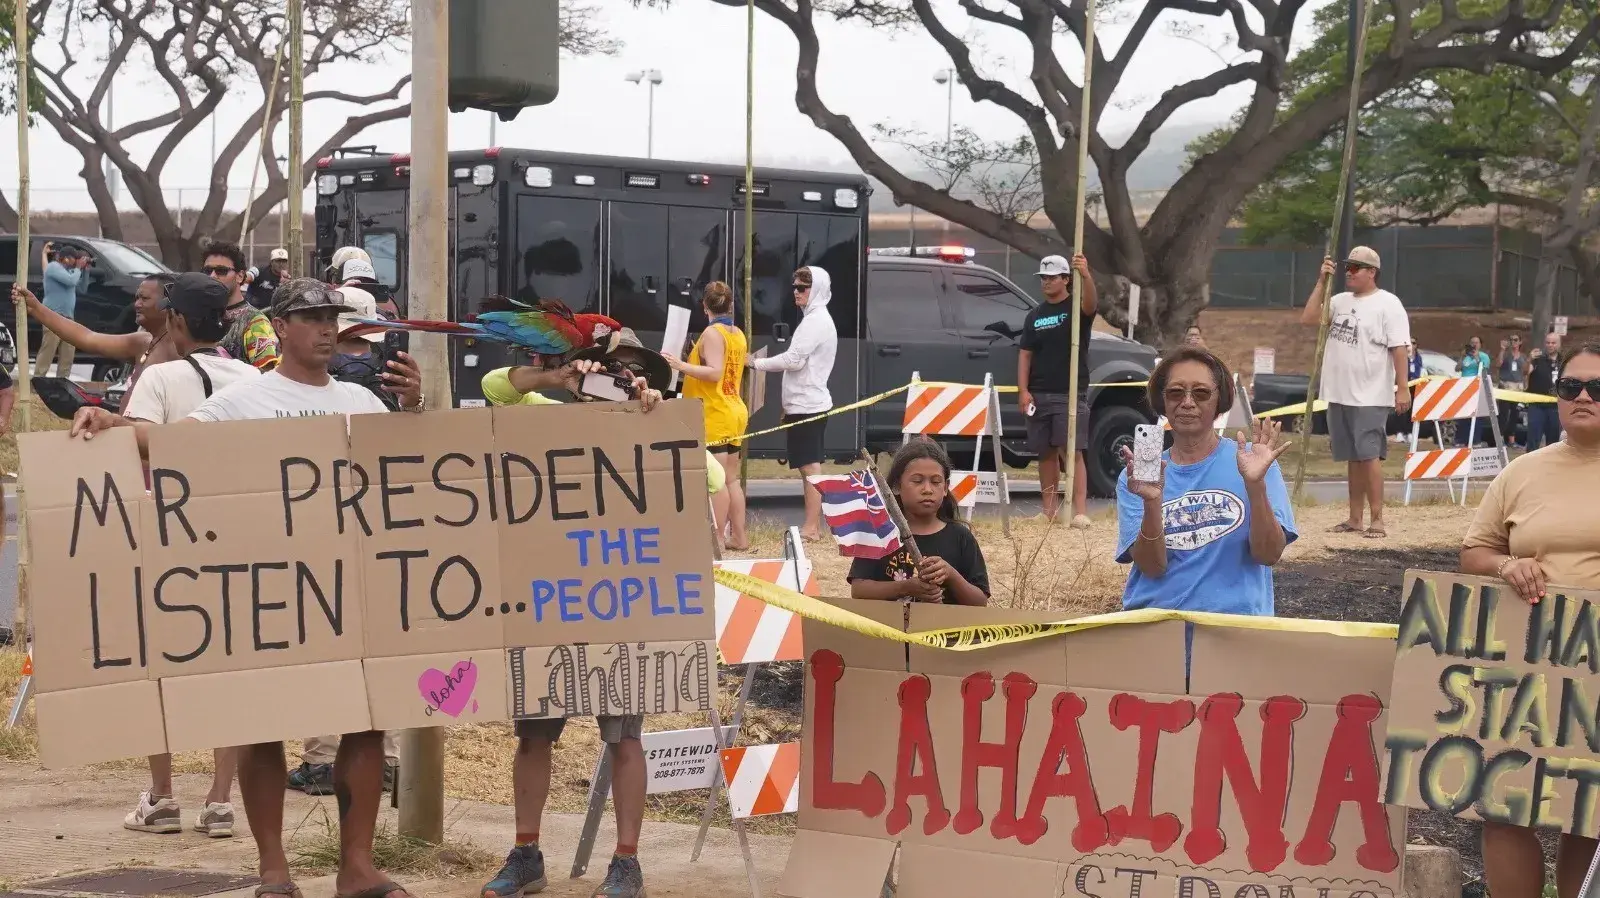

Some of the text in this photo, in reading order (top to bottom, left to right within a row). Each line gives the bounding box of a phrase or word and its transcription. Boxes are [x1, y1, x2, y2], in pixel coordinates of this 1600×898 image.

[1034, 316, 1058, 327] CHOSEN
[69, 439, 699, 557] MR. PRESIDENT
[565, 526, 661, 567] THE
[90, 558, 344, 669] LISTEN
[531, 573, 704, 623] PEOPLE
[1397, 577, 1600, 675] ALL HA
[424, 657, 472, 717] aloha
[654, 766, 705, 779] 808-877-7878
[810, 648, 1399, 873] LAHAINA
